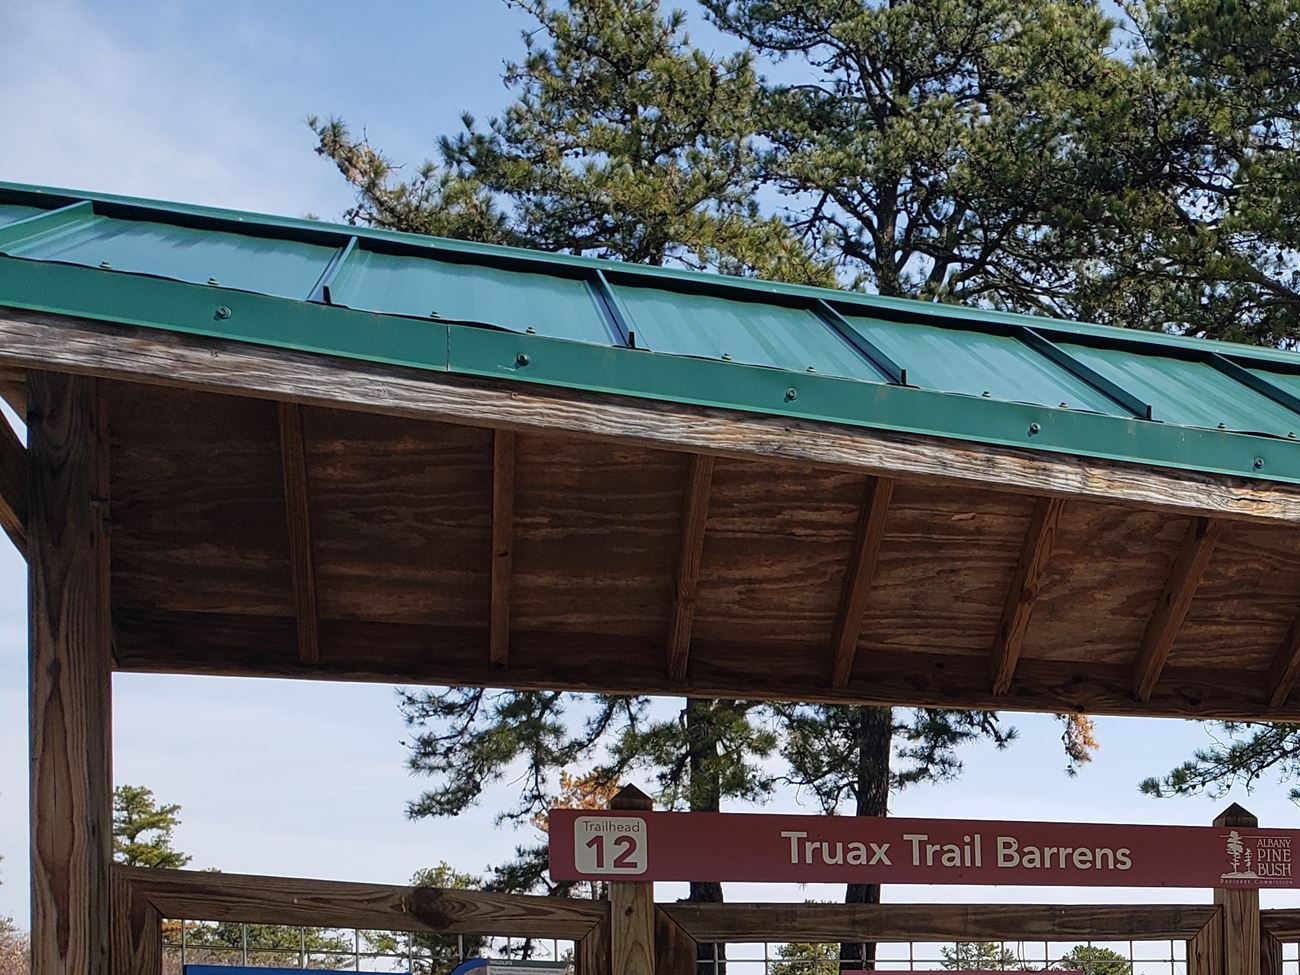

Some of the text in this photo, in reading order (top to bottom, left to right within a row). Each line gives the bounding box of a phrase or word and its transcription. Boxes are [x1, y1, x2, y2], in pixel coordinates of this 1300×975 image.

[583, 821, 640, 832] Trailhead
[1257, 839, 1291, 848] ALBANY
[586, 835, 638, 868] 12
[781, 831, 1132, 871] Truax Trail Barrens
[1257, 849, 1291, 861] PINE
[1258, 863, 1291, 876] BUSH
